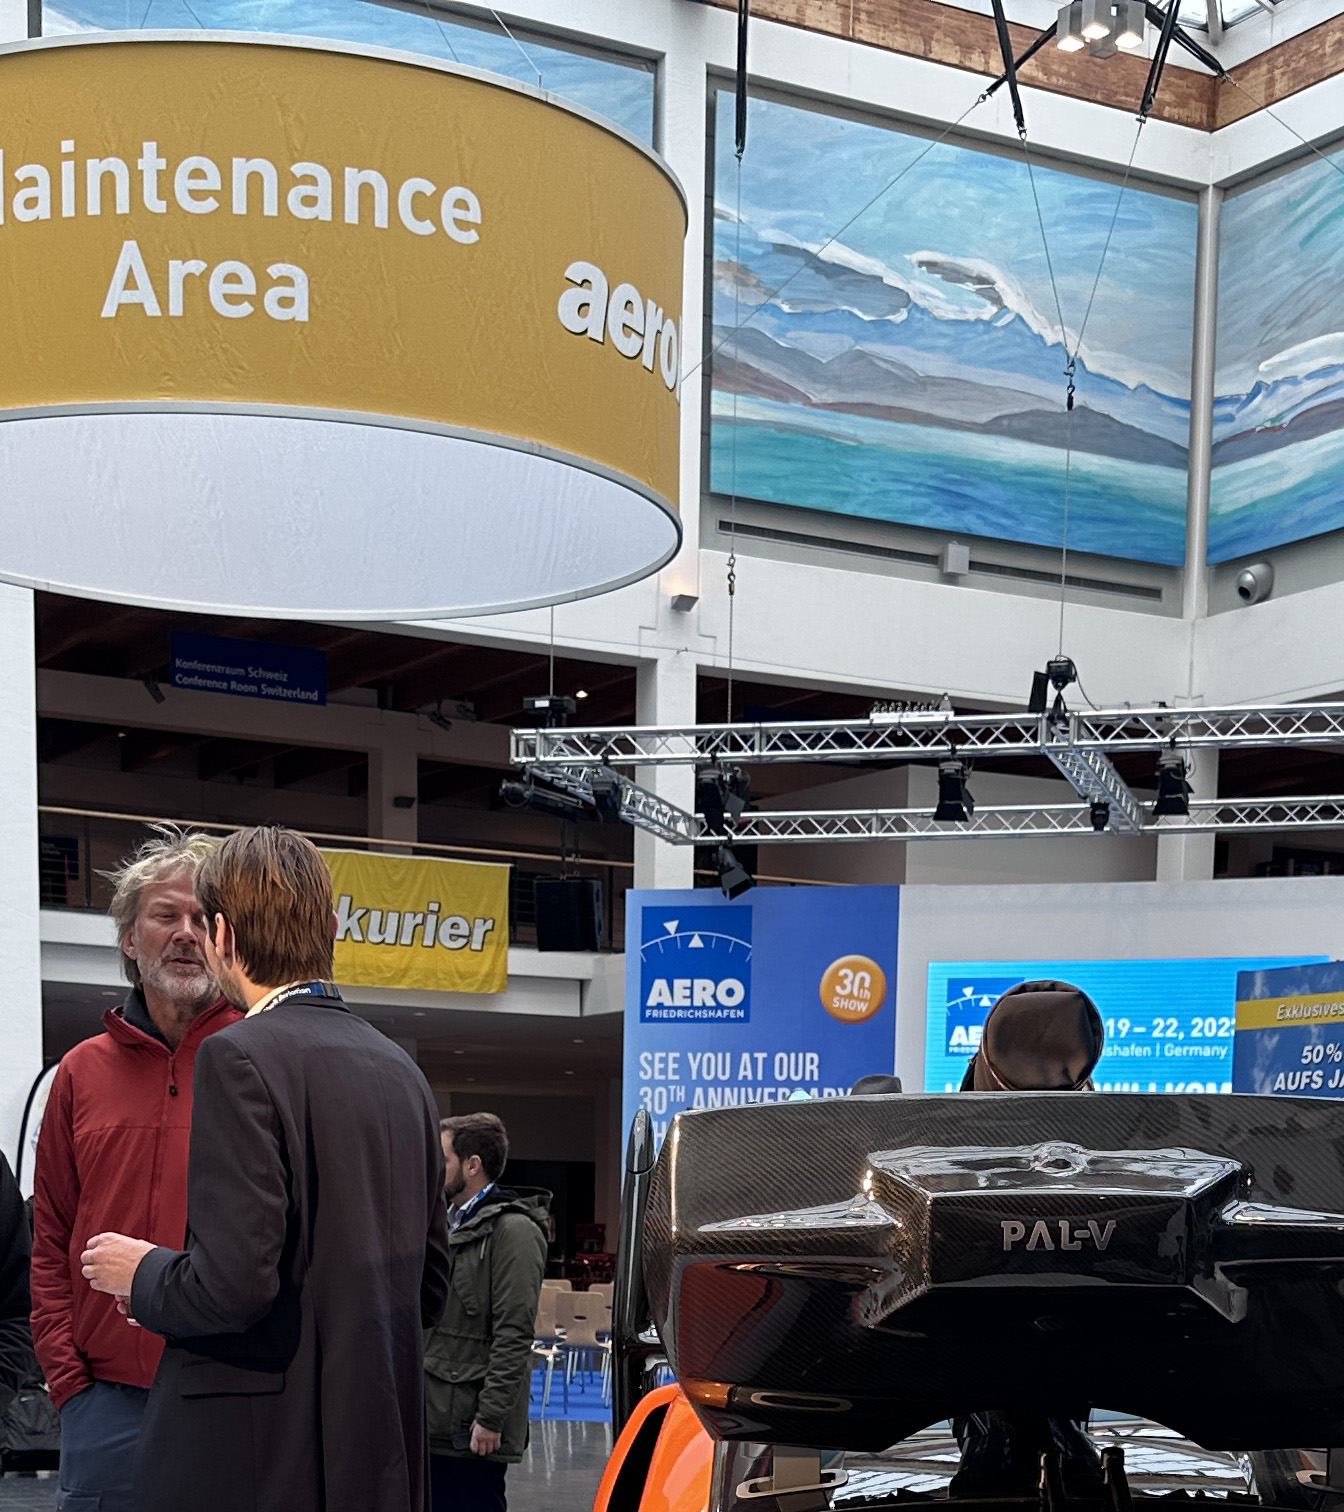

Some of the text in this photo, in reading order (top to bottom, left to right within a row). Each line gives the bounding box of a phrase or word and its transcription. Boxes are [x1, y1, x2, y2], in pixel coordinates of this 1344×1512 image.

[100, 239, 311, 322] Area
[557, 260, 682, 407] aero
[175, 657, 289, 682] Konferenzraum Schweiz
[175, 674, 319, 701] Conference Room Switzerland
[335, 893, 495, 952] kurier
[646, 977, 746, 1008] AERO
[645, 1009, 745, 1019] FRIEDRICHSHAFEN
[832, 997, 869, 1013] SHOW
[949, 1025, 983, 1046] AE
[1106, 1018, 1131, 1038] 19
[1152, 1017, 1184, 1041] 22,
[1102, 1043, 1152, 1057] shafen
[1164, 1043, 1229, 1060] Germany
[1301, 1042, 1343, 1064] 50%
[639, 1052, 819, 1081] SEE YOU AT OUR
[1273, 1069, 1323, 1092] AUFS
[692, 1086, 852, 1109] ANNIVER
[1001, 1220, 1117, 1251] PAL-V
